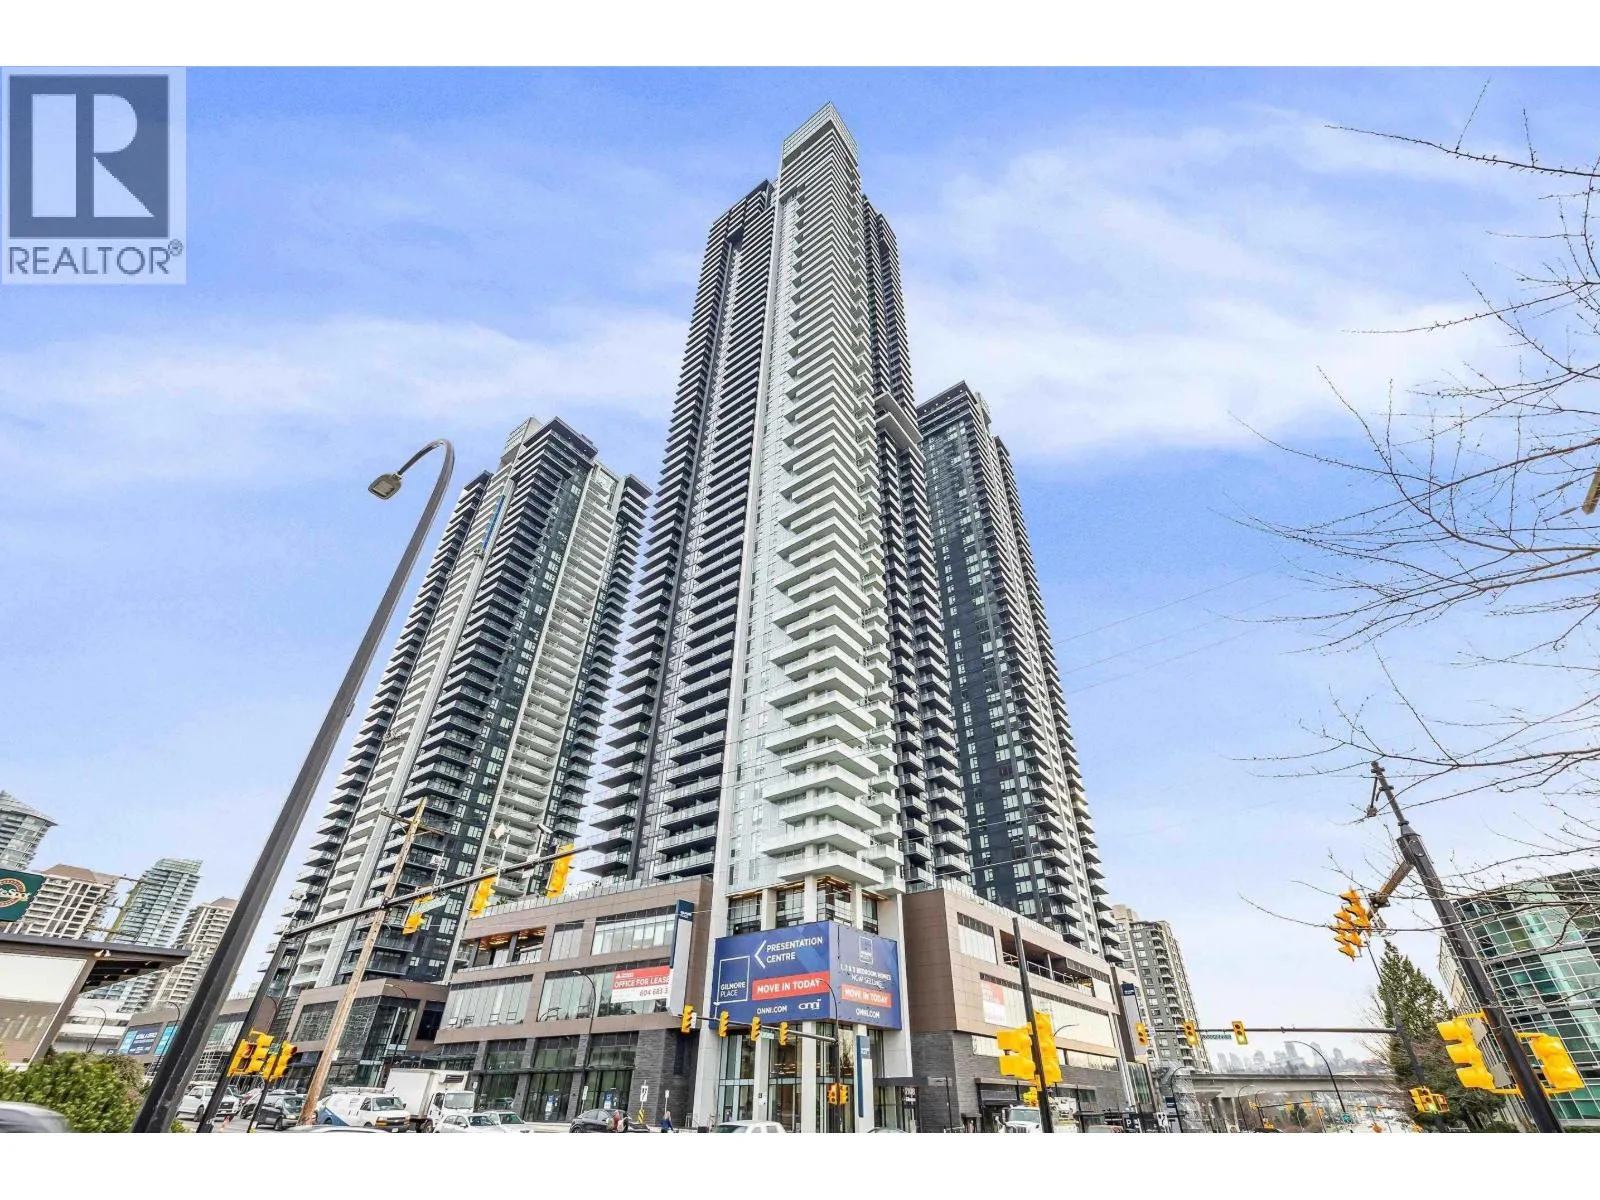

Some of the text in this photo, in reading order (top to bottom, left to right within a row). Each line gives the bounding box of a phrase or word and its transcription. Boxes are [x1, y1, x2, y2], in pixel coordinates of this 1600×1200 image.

[766, 936, 823, 953] PRESENTATION
[766, 952, 796, 963] CENTRE
[856, 967, 877, 978] BEDROOM
[614, 976, 670, 988] OFFICE FOR LEASE
[720, 981, 746, 991] GILMORE
[757, 979, 821, 994] MOVE IN TODAY
[720, 989, 738, 997] PLACE
[845, 988, 888, 1002] MOVE IN TODAY
[756, 1005, 788, 1014] ONNI.COM
